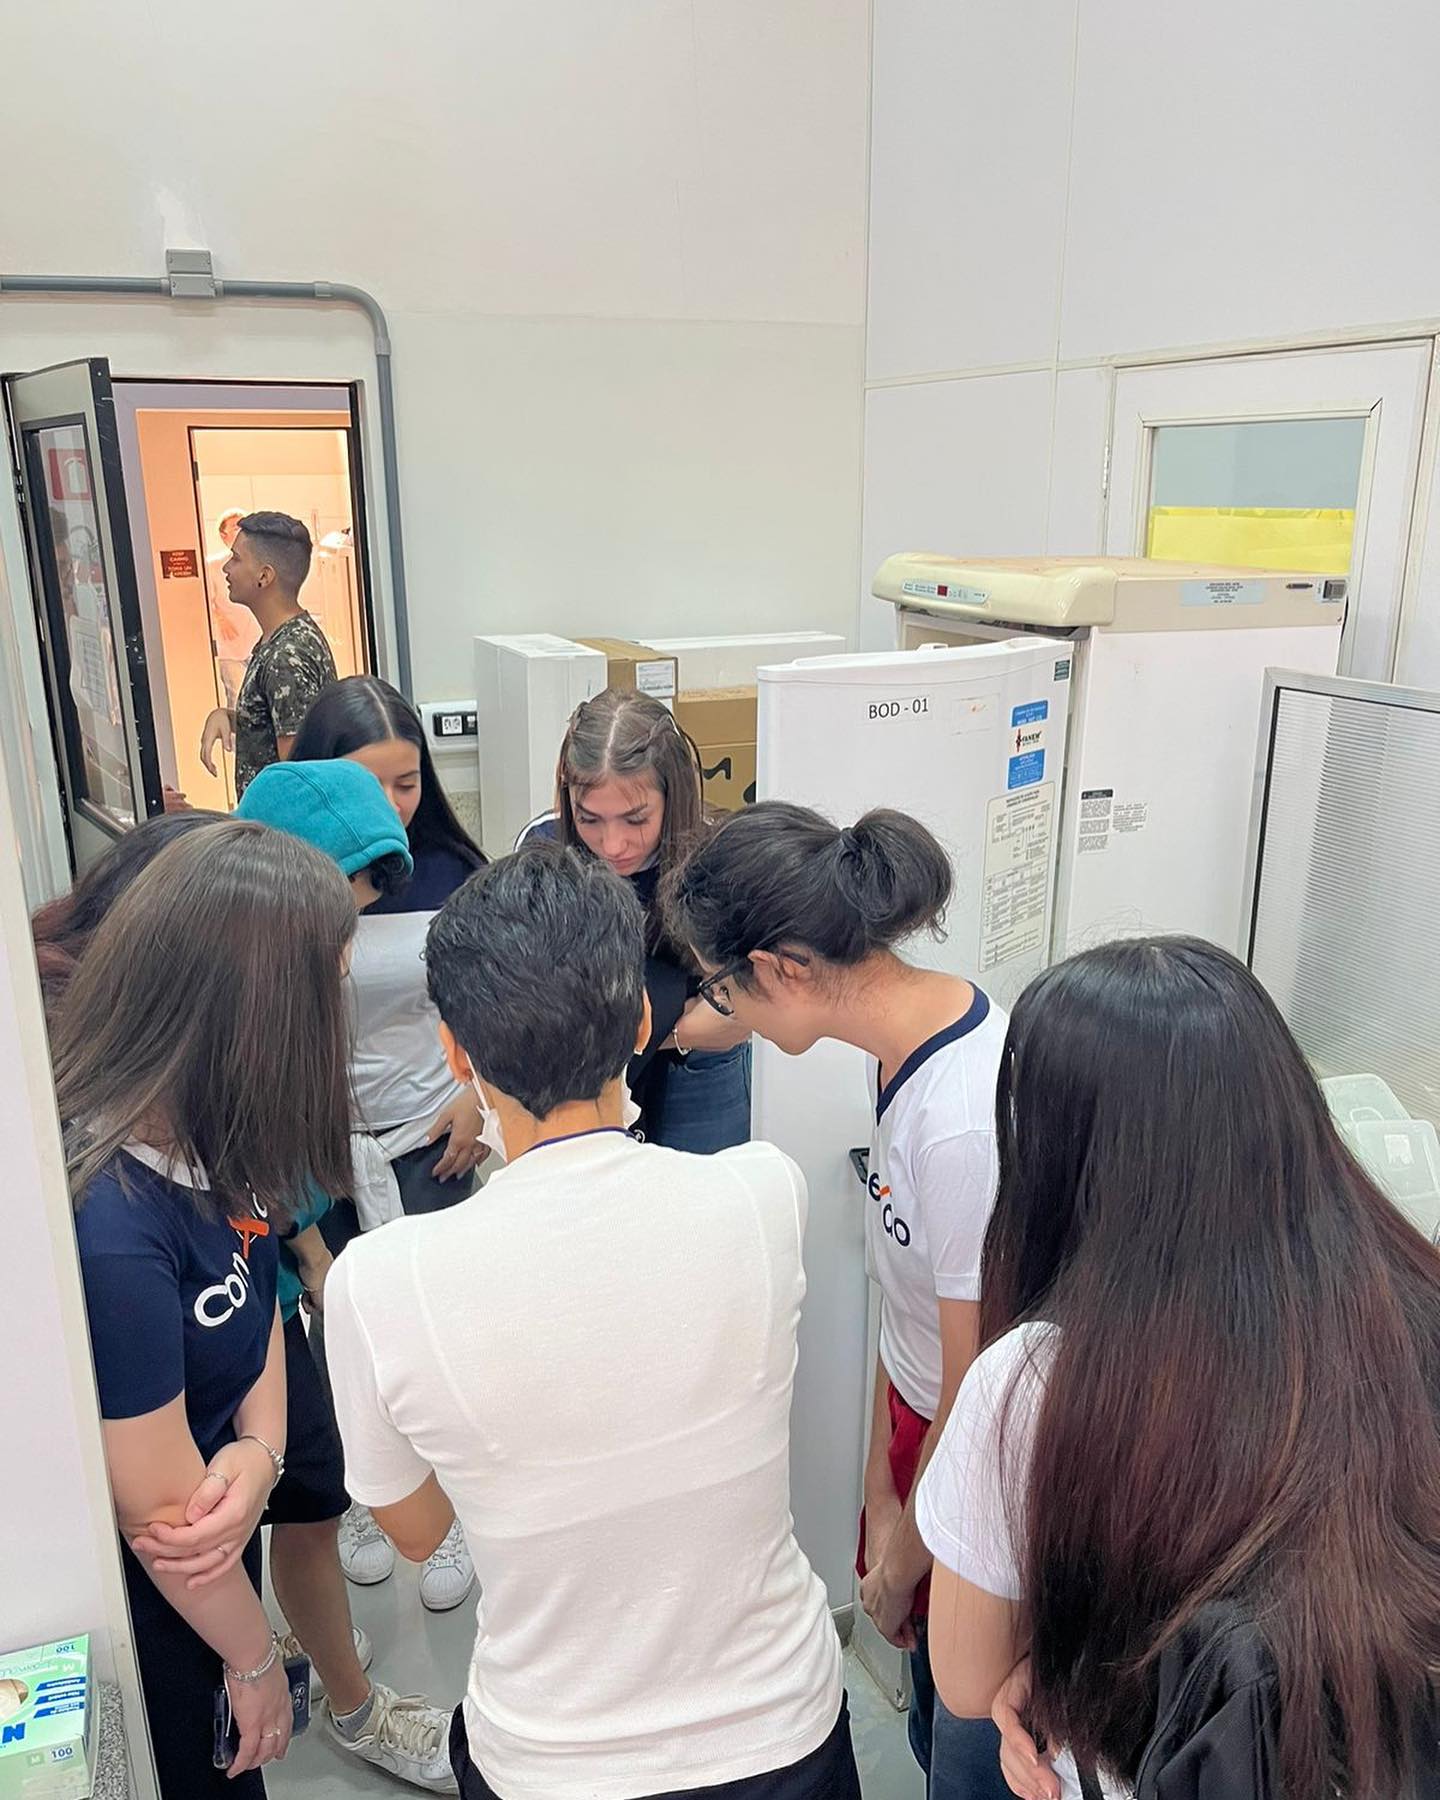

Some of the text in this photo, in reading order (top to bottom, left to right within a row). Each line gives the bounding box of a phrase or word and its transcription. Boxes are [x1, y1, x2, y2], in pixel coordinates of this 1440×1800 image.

[869, 703, 900, 719] BOD
[912, 698, 929, 714] 01
[52, 1747, 73, 1758] 100
